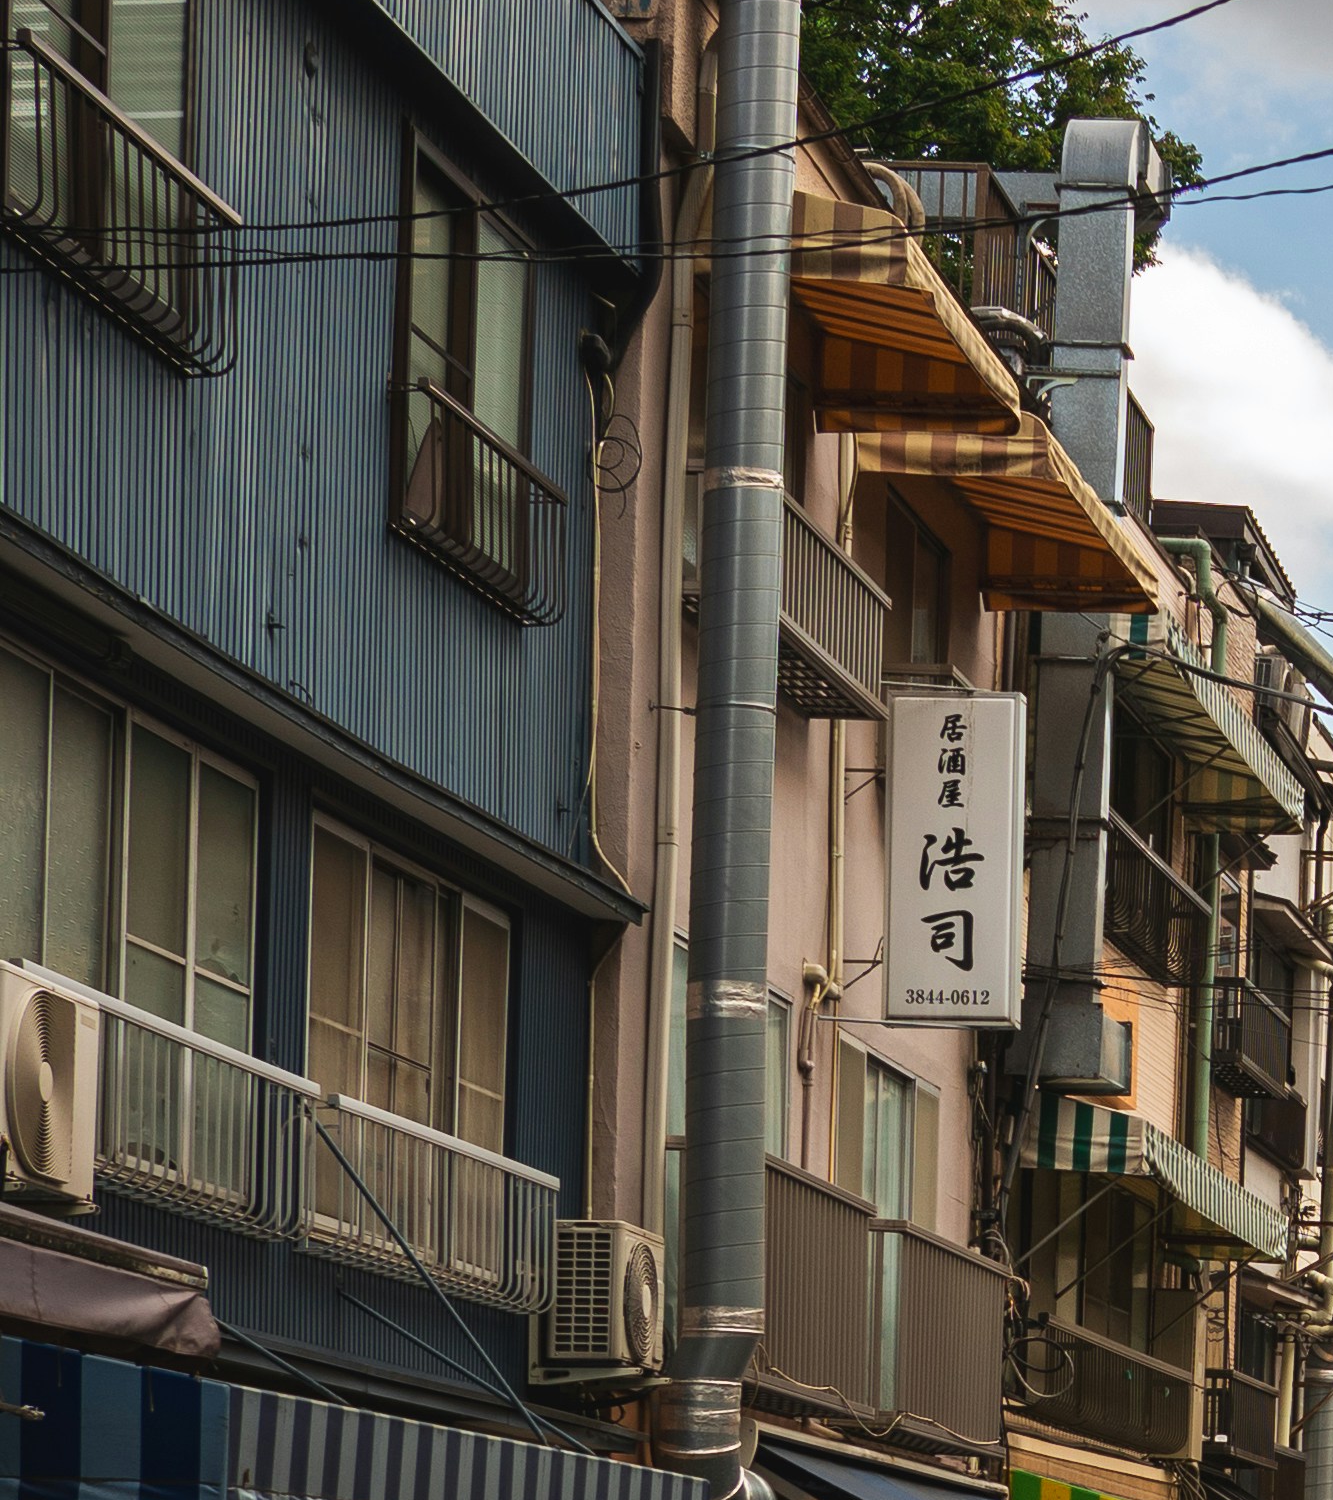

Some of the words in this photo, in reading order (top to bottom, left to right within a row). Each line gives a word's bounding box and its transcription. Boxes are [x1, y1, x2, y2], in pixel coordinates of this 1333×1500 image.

[937, 713, 968, 809] 居酒屋
[919, 827, 985, 972] 浩司
[905, 988, 991, 1006] 3844-0612
